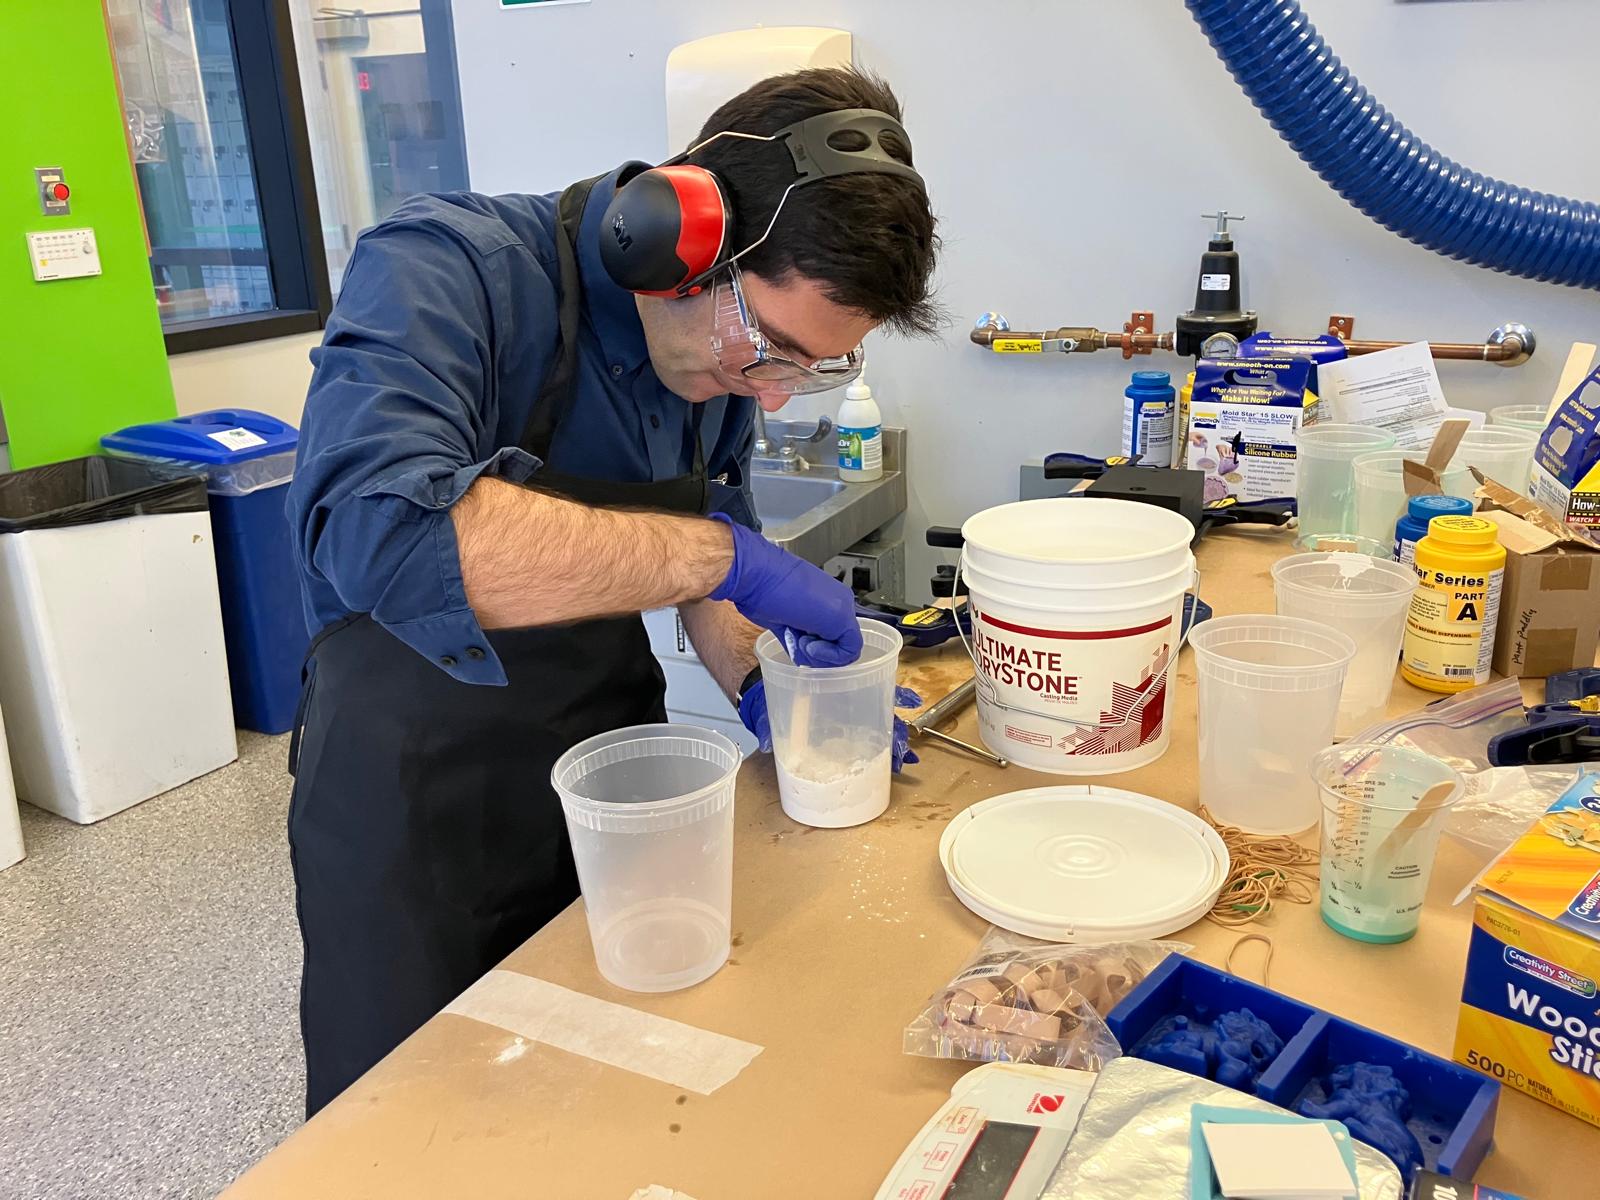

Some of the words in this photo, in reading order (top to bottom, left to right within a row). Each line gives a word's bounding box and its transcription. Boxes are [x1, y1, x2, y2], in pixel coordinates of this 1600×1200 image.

[1216, 361, 1291, 370] www.smooth-on.com
[1211, 386, 1225, 395] What
[1226, 387, 1238, 395] Are
[1249, 388, 1273, 397] Waiting
[1221, 394, 1243, 403] Make
[1250, 396, 1270, 404] Now!
[1244, 448, 1271, 457] Silicone
[1271, 450, 1297, 459] Rubber
[1434, 572, 1485, 587] Series
[1454, 592, 1485, 601] PART
[1456, 602, 1478, 621] A
[1418, 626, 1437, 635] BEFORE
[974, 627, 1062, 672] ULTIMATE
[975, 647, 1078, 695] DRYSTONE
[1039, 692, 1061, 701] Casting
[1509, 949, 1556, 977] Creativity
[1557, 970, 1588, 989] Street
[1466, 1048, 1506, 1079] 500
[1507, 1068, 1525, 1088] PC
[1527, 1077, 1553, 1096] NATURAL
